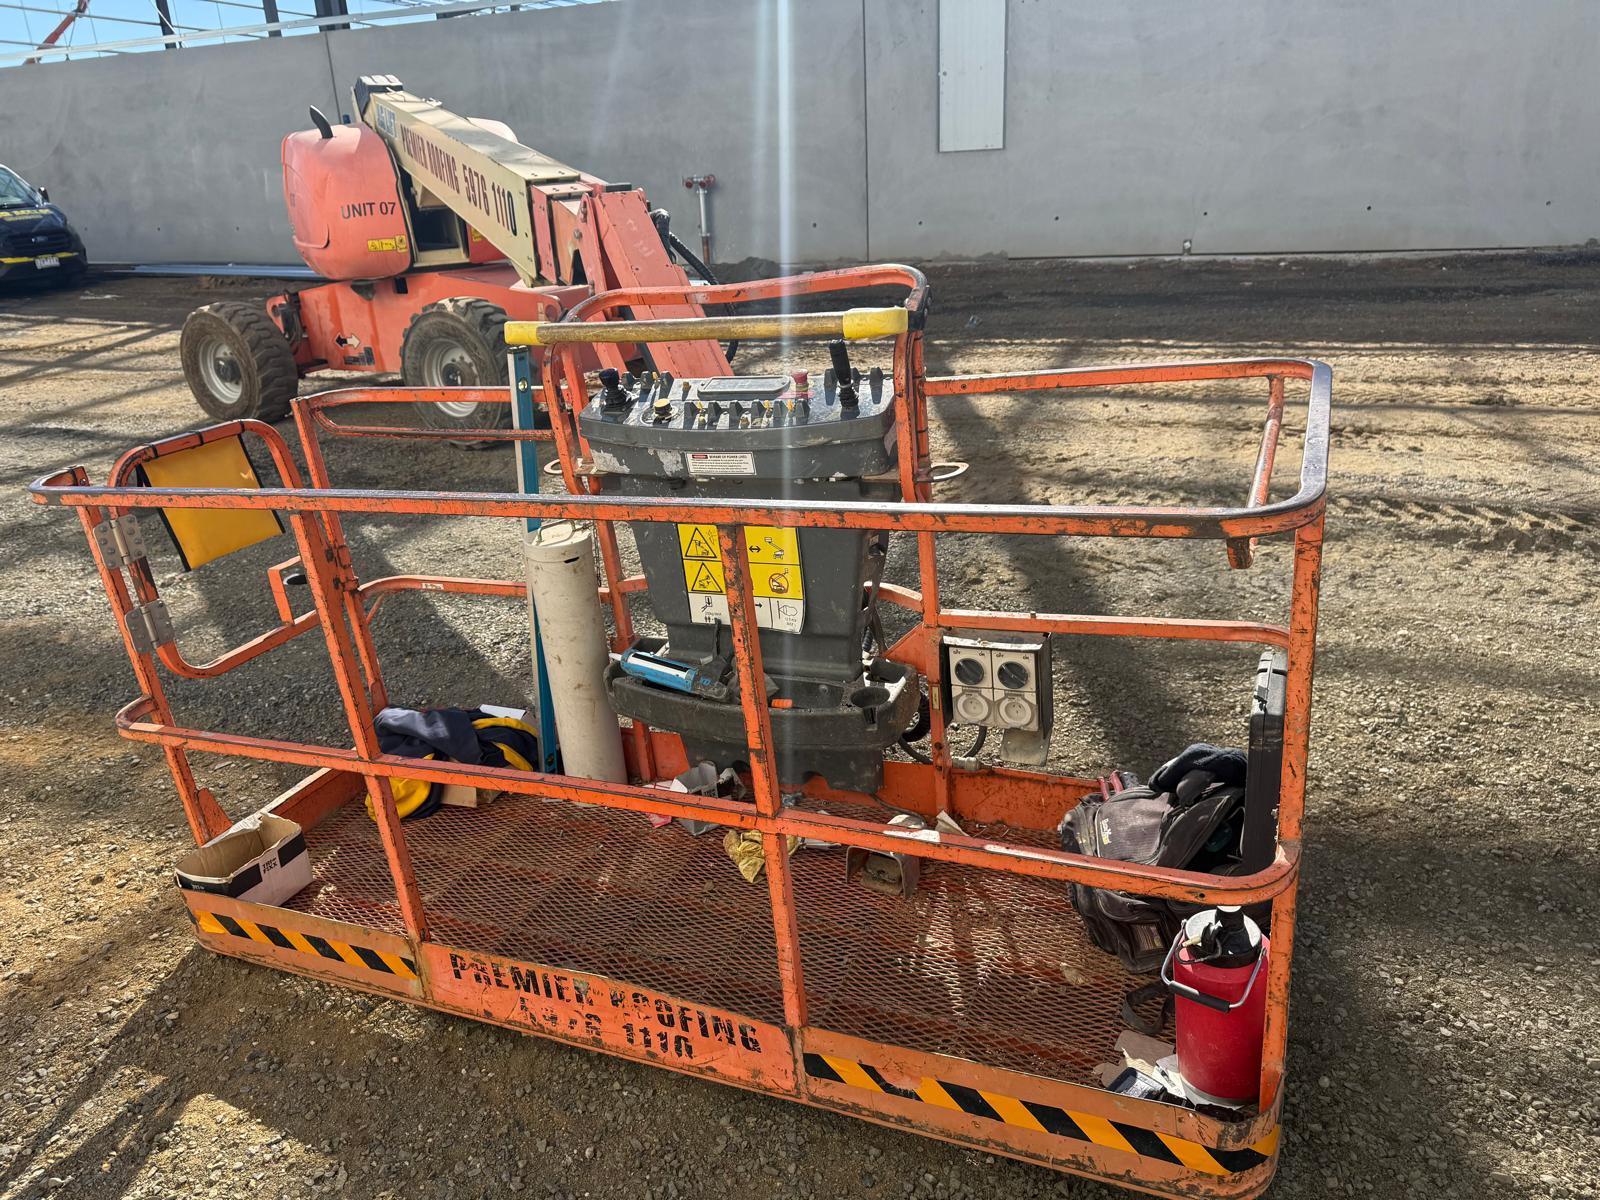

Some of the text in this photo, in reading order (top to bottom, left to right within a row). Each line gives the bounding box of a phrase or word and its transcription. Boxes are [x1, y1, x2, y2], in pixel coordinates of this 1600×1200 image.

[341, 201, 396, 219] UNIT 07
[426, 140, 460, 194] ROOFING
[462, 163, 490, 216] 5976
[491, 181, 517, 237] 1110
